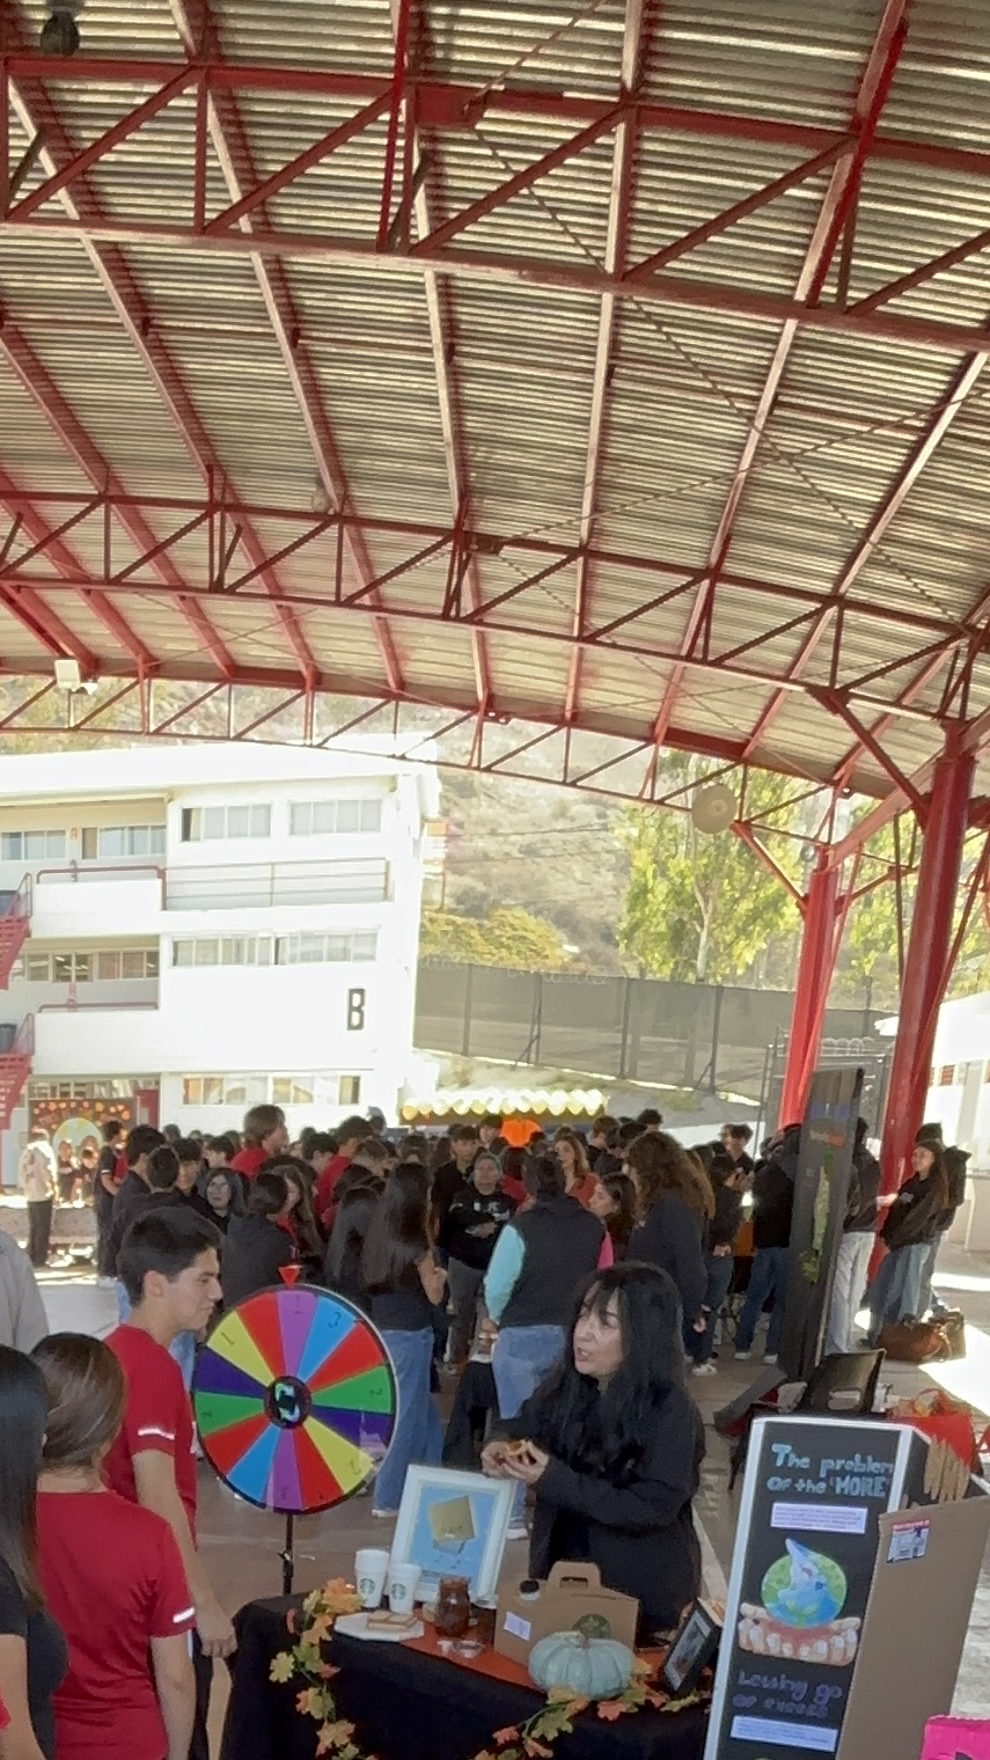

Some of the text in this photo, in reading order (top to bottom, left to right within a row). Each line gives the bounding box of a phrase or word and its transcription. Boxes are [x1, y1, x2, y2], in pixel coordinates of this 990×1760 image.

[347, 988, 365, 1031] B
[771, 1443, 811, 1469] The
[795, 1479, 827, 1494] the
[813, 1683, 843, 1705] go
